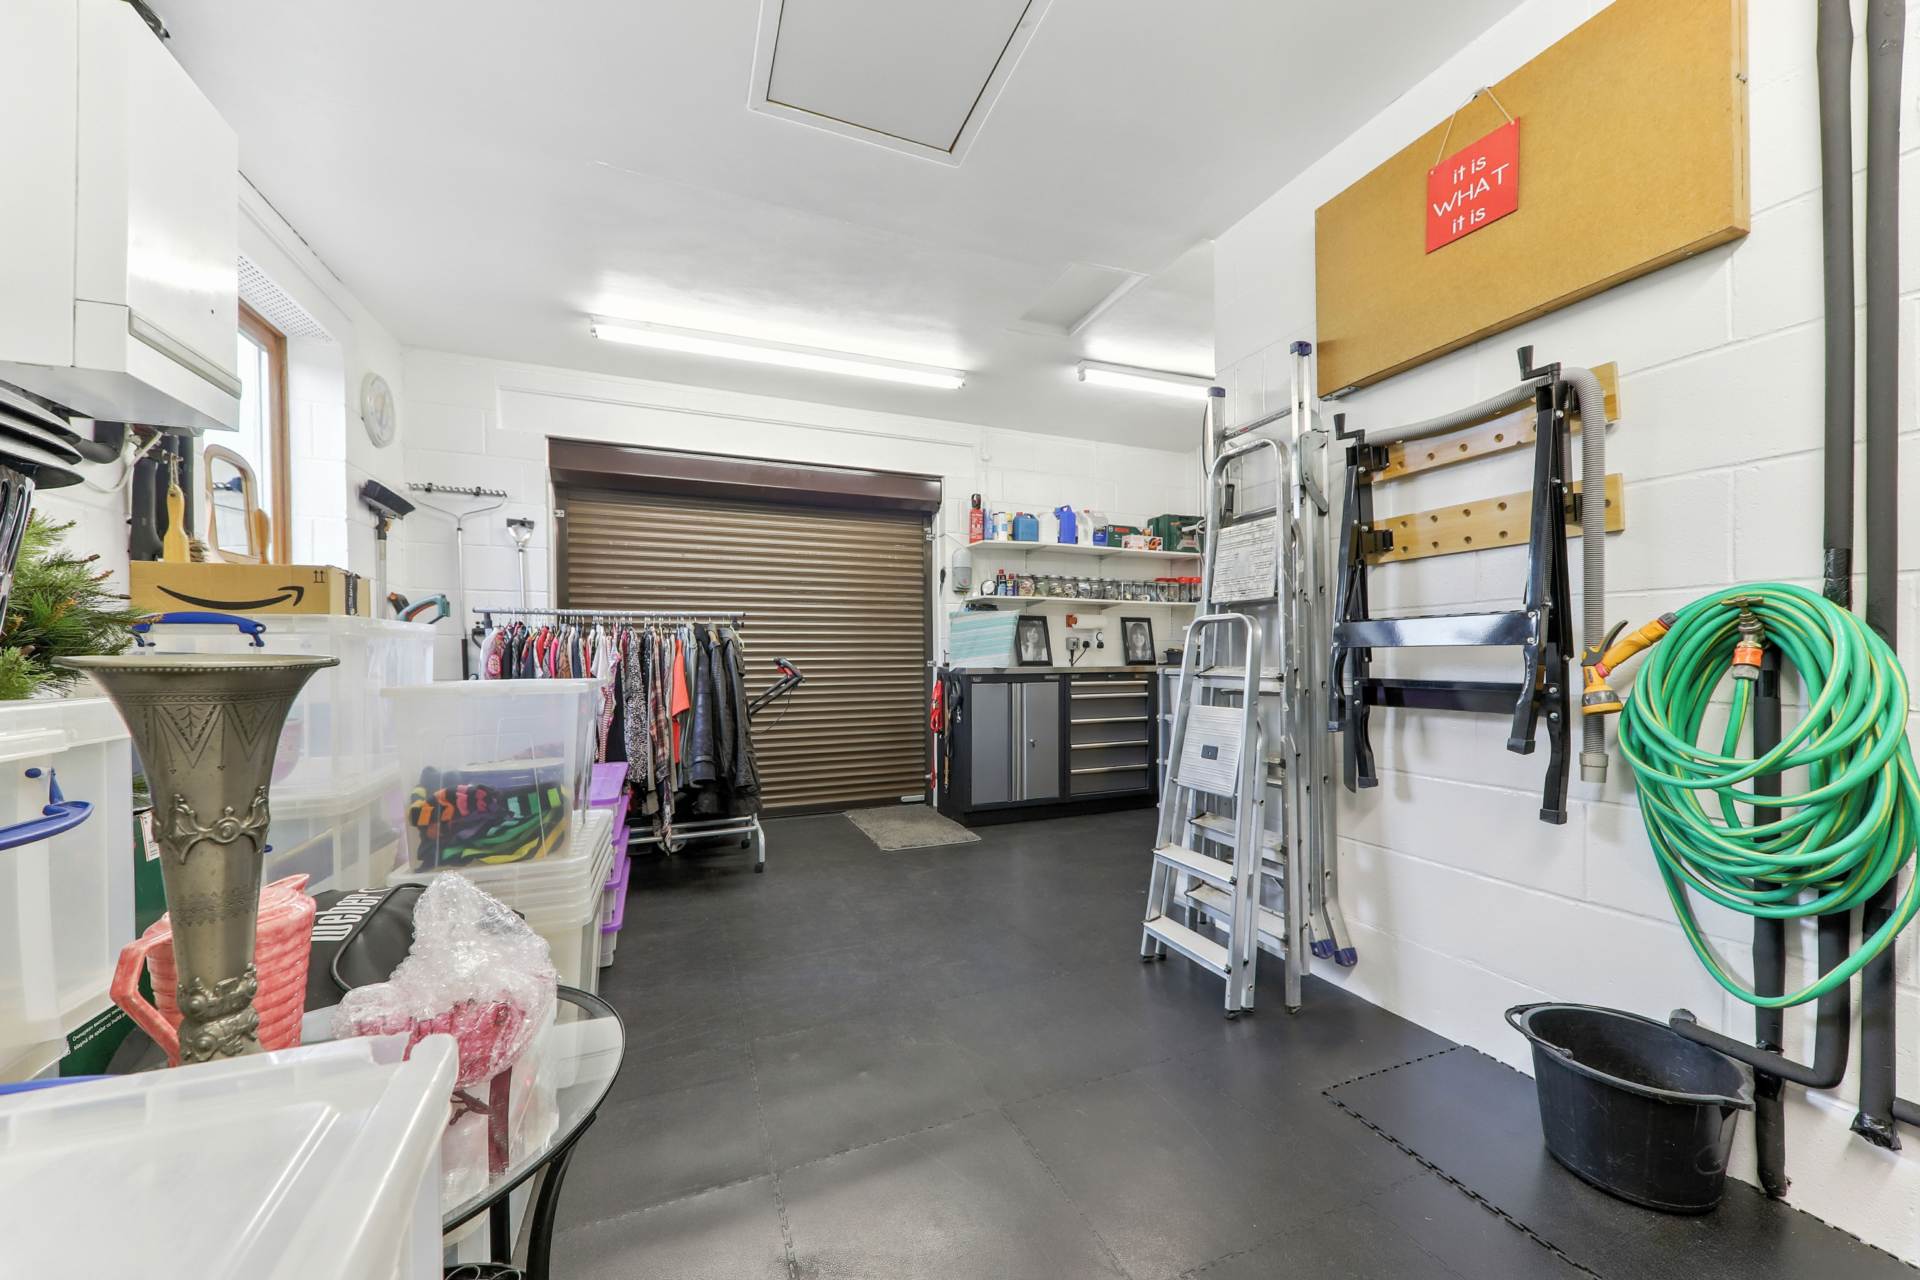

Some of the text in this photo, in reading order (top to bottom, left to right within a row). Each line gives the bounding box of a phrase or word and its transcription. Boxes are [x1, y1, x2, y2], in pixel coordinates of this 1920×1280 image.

[1453, 156, 1486, 184] it is
[1433, 163, 1509, 217] WHAT
[1452, 207, 1486, 234] it is
